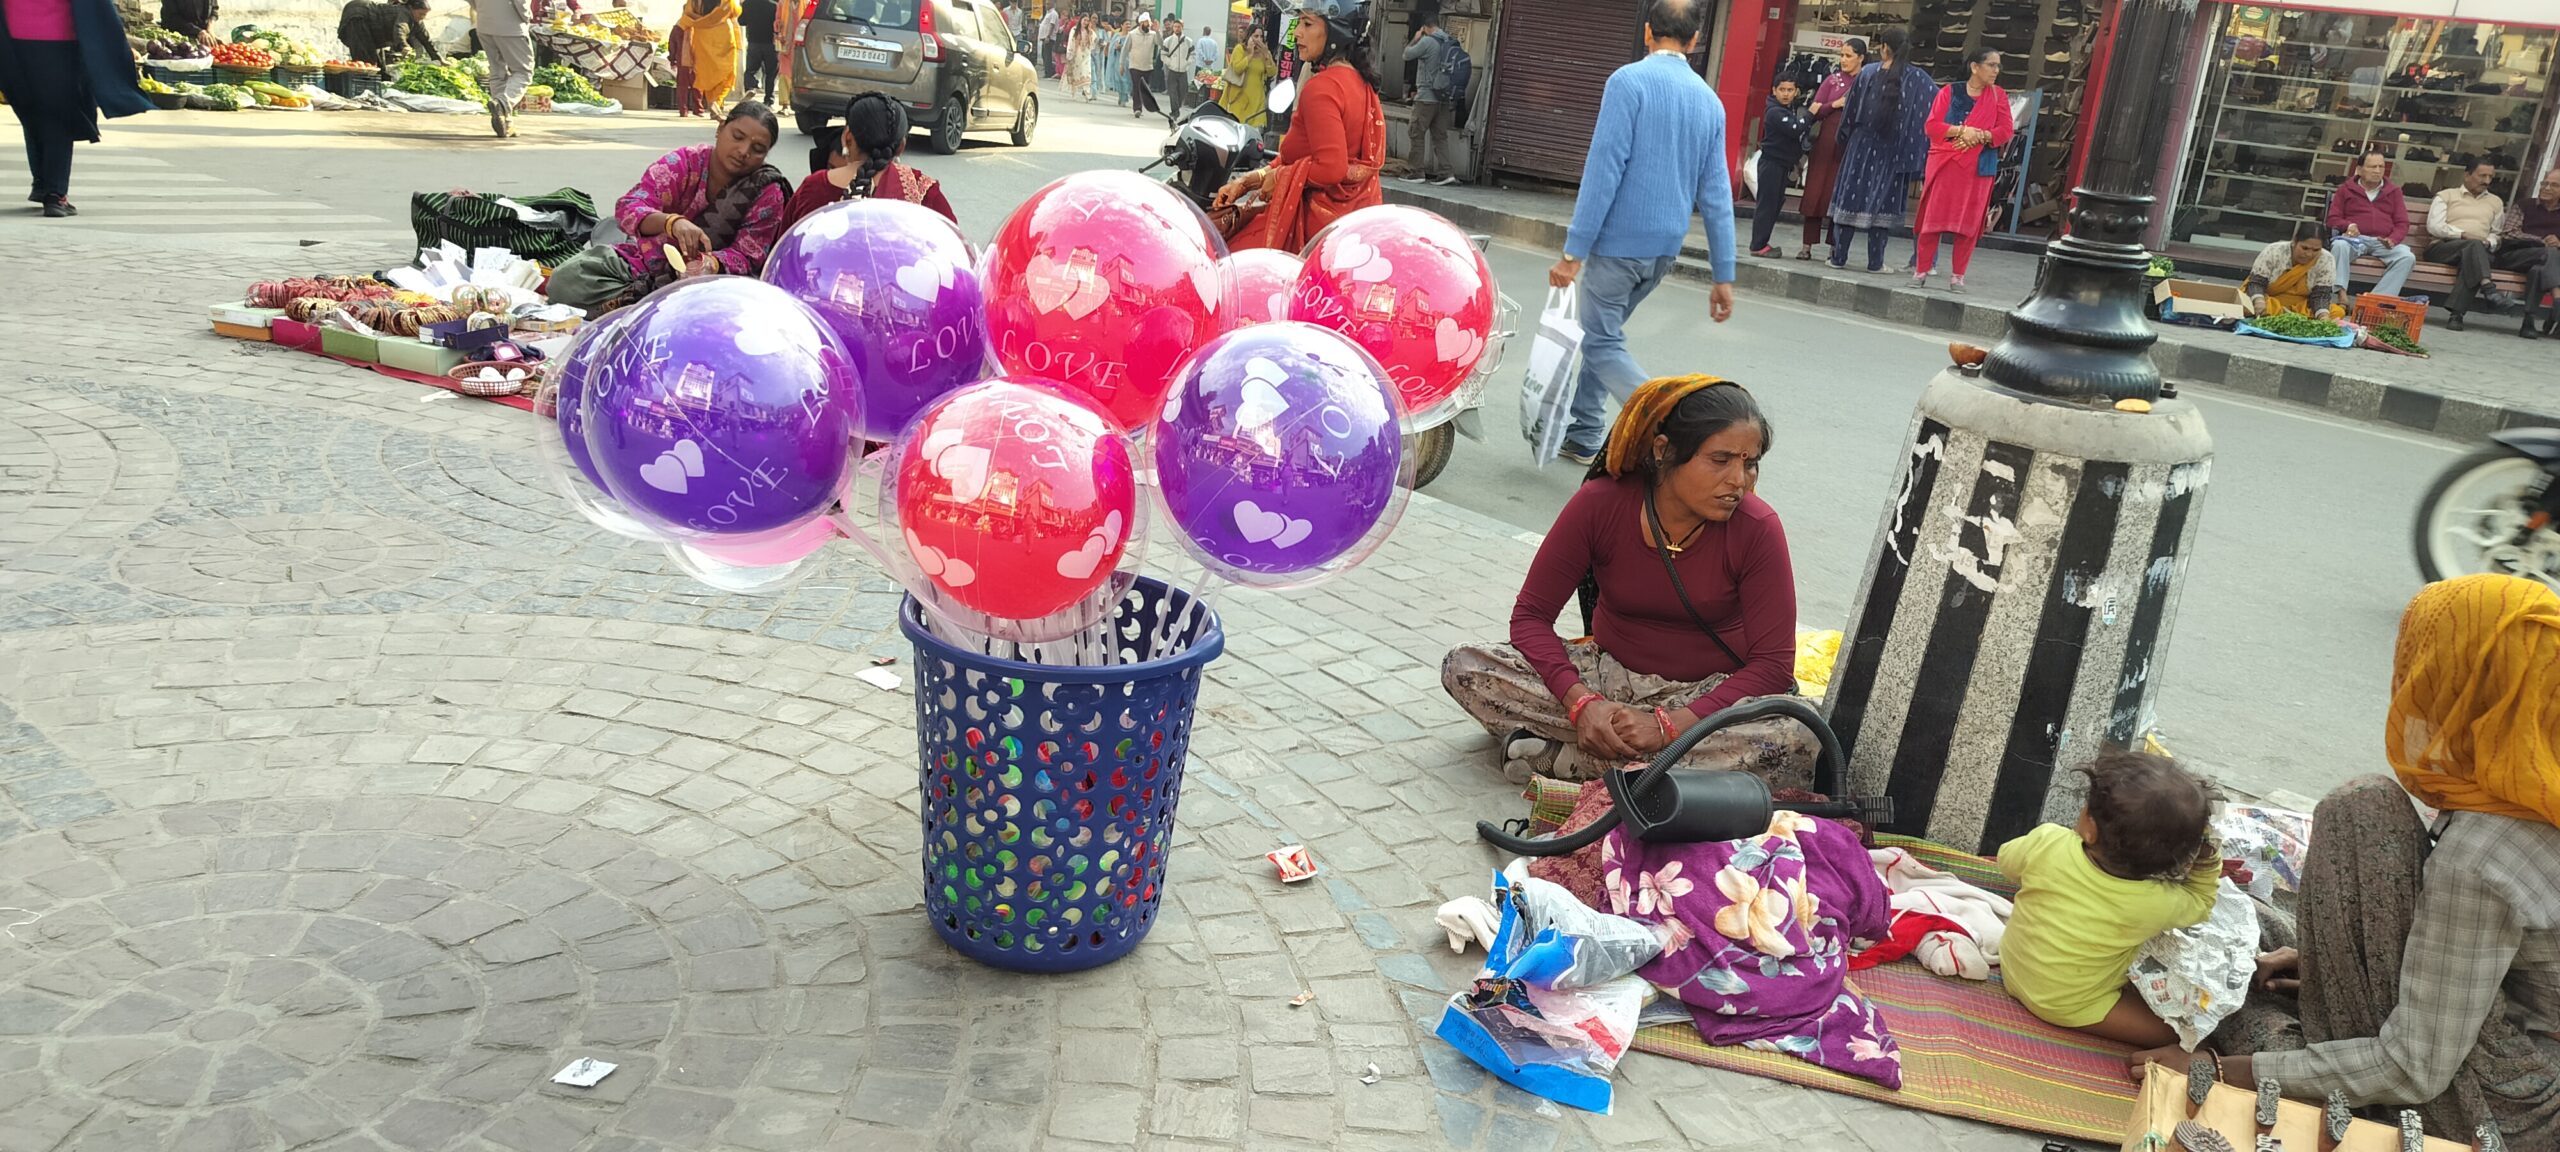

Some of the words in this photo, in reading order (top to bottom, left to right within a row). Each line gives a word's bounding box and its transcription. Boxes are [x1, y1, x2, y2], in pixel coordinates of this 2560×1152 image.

[1295, 276, 1369, 335] LOVE
[594, 331, 674, 402] OVE
[908, 306, 984, 373] LOV
[1000, 329, 1128, 389] LOVE
[1376, 364, 1444, 410] LOV
[987, 400, 1071, 473] LOV
[688, 457, 789, 532] LOVE
